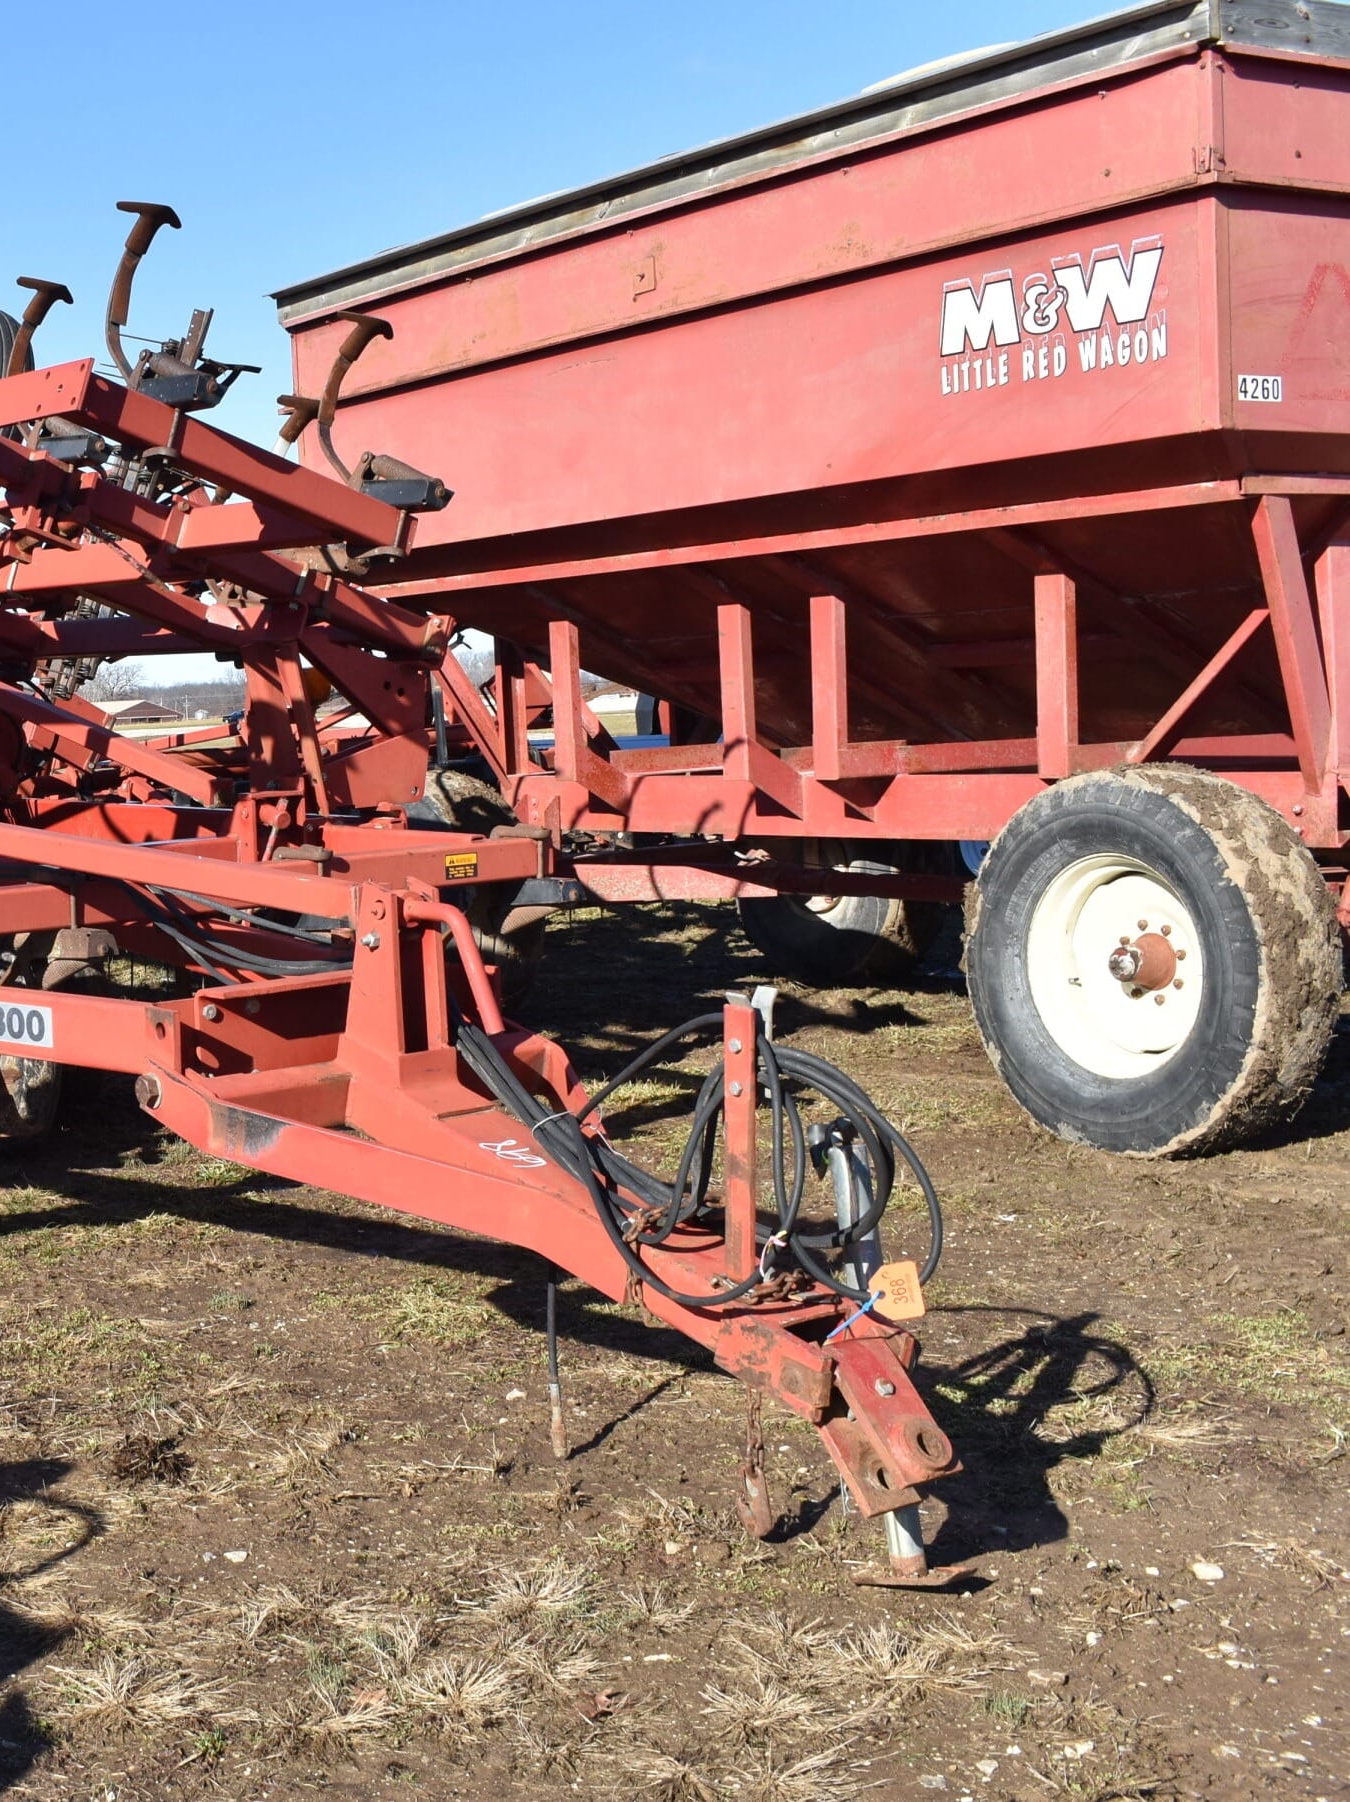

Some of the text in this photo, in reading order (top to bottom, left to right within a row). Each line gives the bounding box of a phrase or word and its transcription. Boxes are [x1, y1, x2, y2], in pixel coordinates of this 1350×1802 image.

[940, 246, 1164, 357] M&W
[941, 324, 1168, 396] LITTLE RED WAGON
[1238, 377, 1281, 401] 4260
[889, 1278, 909, 1305] 368
